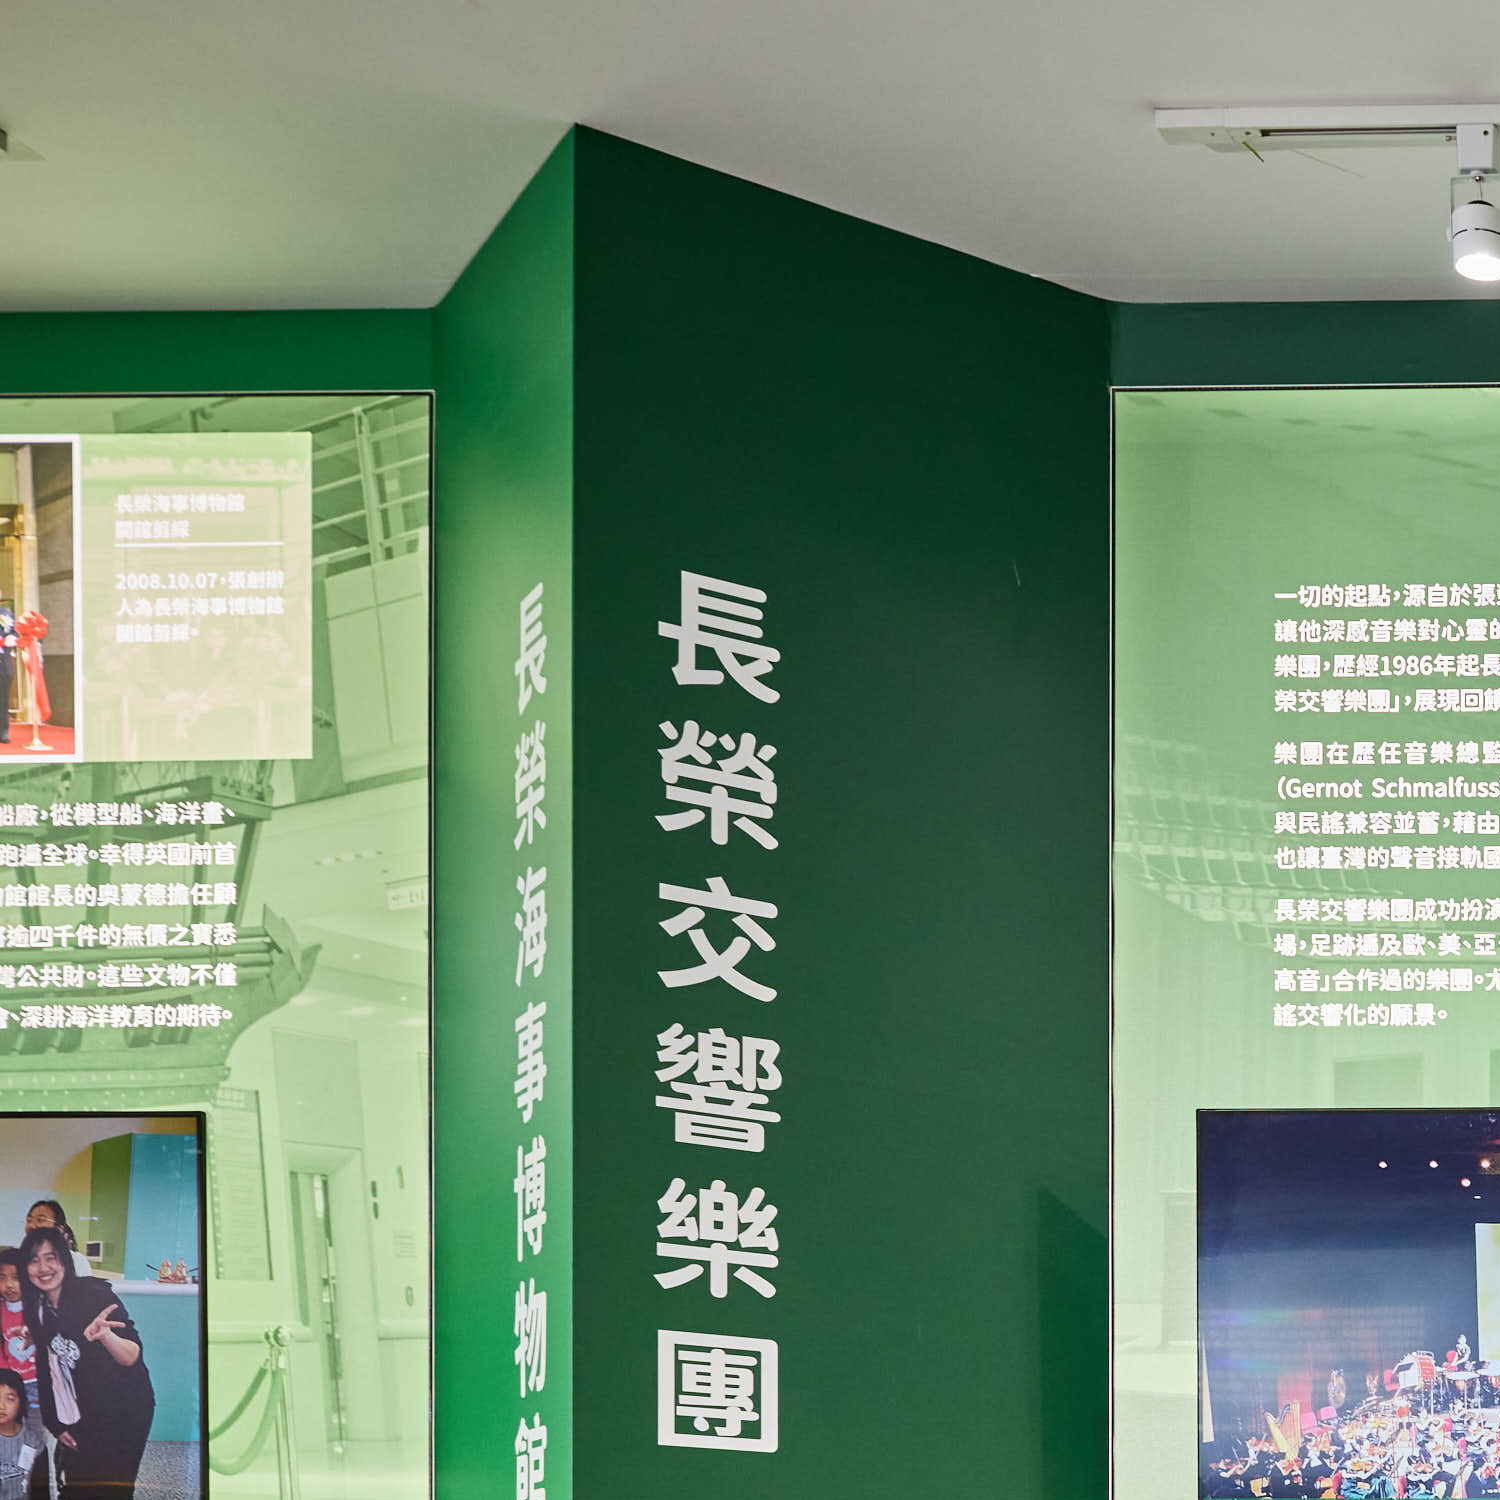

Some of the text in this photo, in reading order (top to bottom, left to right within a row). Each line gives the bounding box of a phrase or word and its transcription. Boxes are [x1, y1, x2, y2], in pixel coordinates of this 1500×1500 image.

[0, 883, 236, 907] 館館長的奧蒙德擔任顧
[0, 923, 237, 947] 逾四千件的無價之寶悉
[654, 570, 782, 1454] 長榮交響樂團
[1273, 1003, 1447, 1026] 謠交響化的願景。
